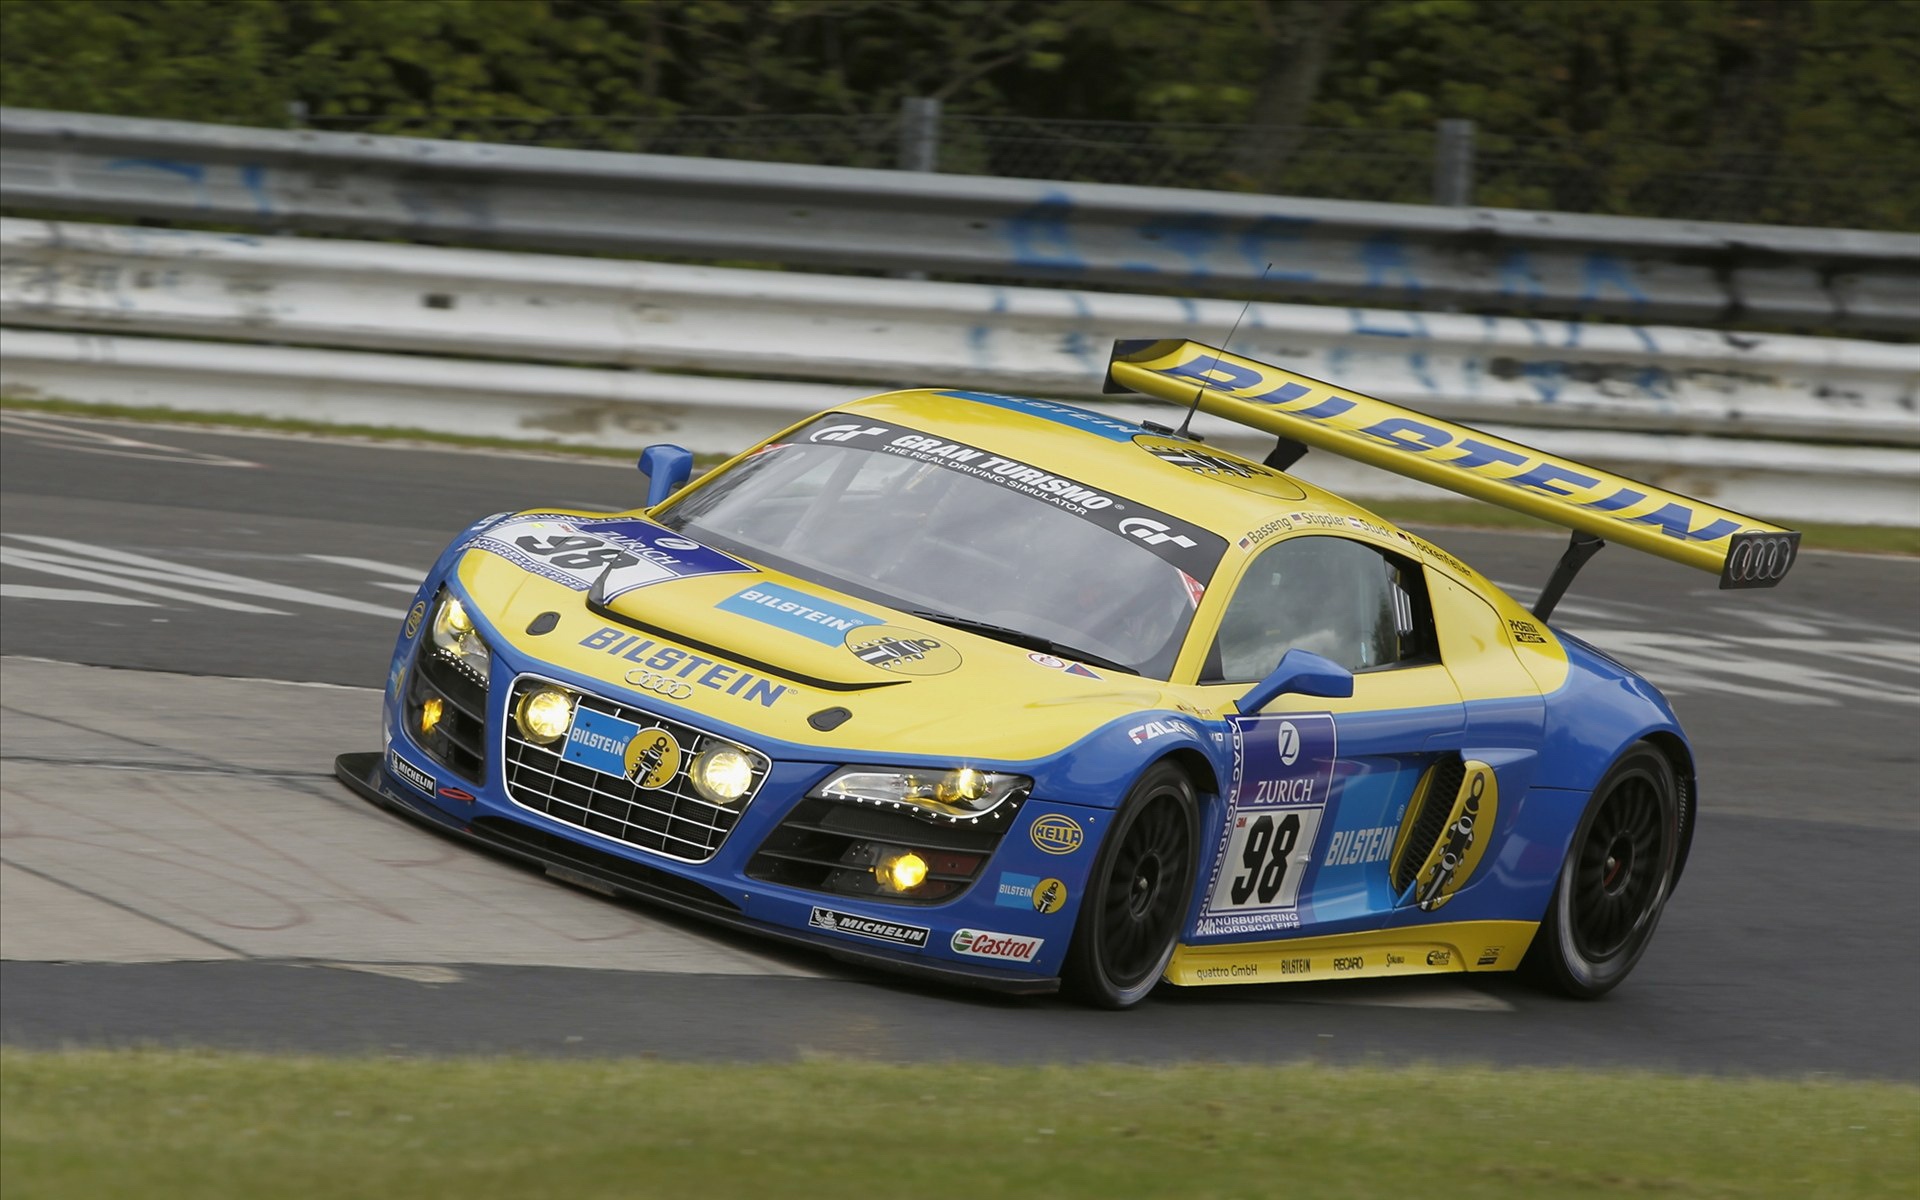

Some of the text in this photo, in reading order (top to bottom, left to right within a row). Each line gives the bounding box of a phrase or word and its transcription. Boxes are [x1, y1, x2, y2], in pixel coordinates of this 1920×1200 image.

[967, 391, 1141, 433] LSTEIN
[1163, 354, 1742, 541] BILSTEIN
[882, 445, 1087, 515] THE REAL DRIVING SIMULATOR
[891, 435, 1113, 510] GRAN TURISMO
[1247, 515, 1293, 544] Basseng
[1301, 512, 1346, 528] Stippler
[1359, 518, 1393, 539] Stuck
[515, 535, 640, 569] 98
[593, 531, 681, 565] ZURICH
[739, 590, 853, 631] BILSTEIN
[578, 627, 788, 708] BILSTEIN
[571, 726, 626, 756] BILSTEIN
[399, 761, 434, 791] MICHELIN
[1254, 778, 1314, 804] ZURICH
[1200, 719, 1241, 917] ADAC NORDRHEIN
[1236, 817, 1248, 828] 3M
[1035, 824, 1082, 847] HELLA
[1324, 825, 1398, 867] BILSTEIN
[1231, 813, 1300, 905] 98
[999, 883, 1033, 898] BILSTEIN
[839, 916, 925, 943] MICHELIN
[1196, 912, 1298, 935] 24h NÜRBURGRING
[1216, 922, 1300, 935] NORDSCHLEIFE
[971, 933, 1036, 960] Castrol
[1196, 964, 1258, 980] quattro GmbH
[1281, 958, 1311, 974] BILSTEIN
[1334, 956, 1364, 971] RECARO
